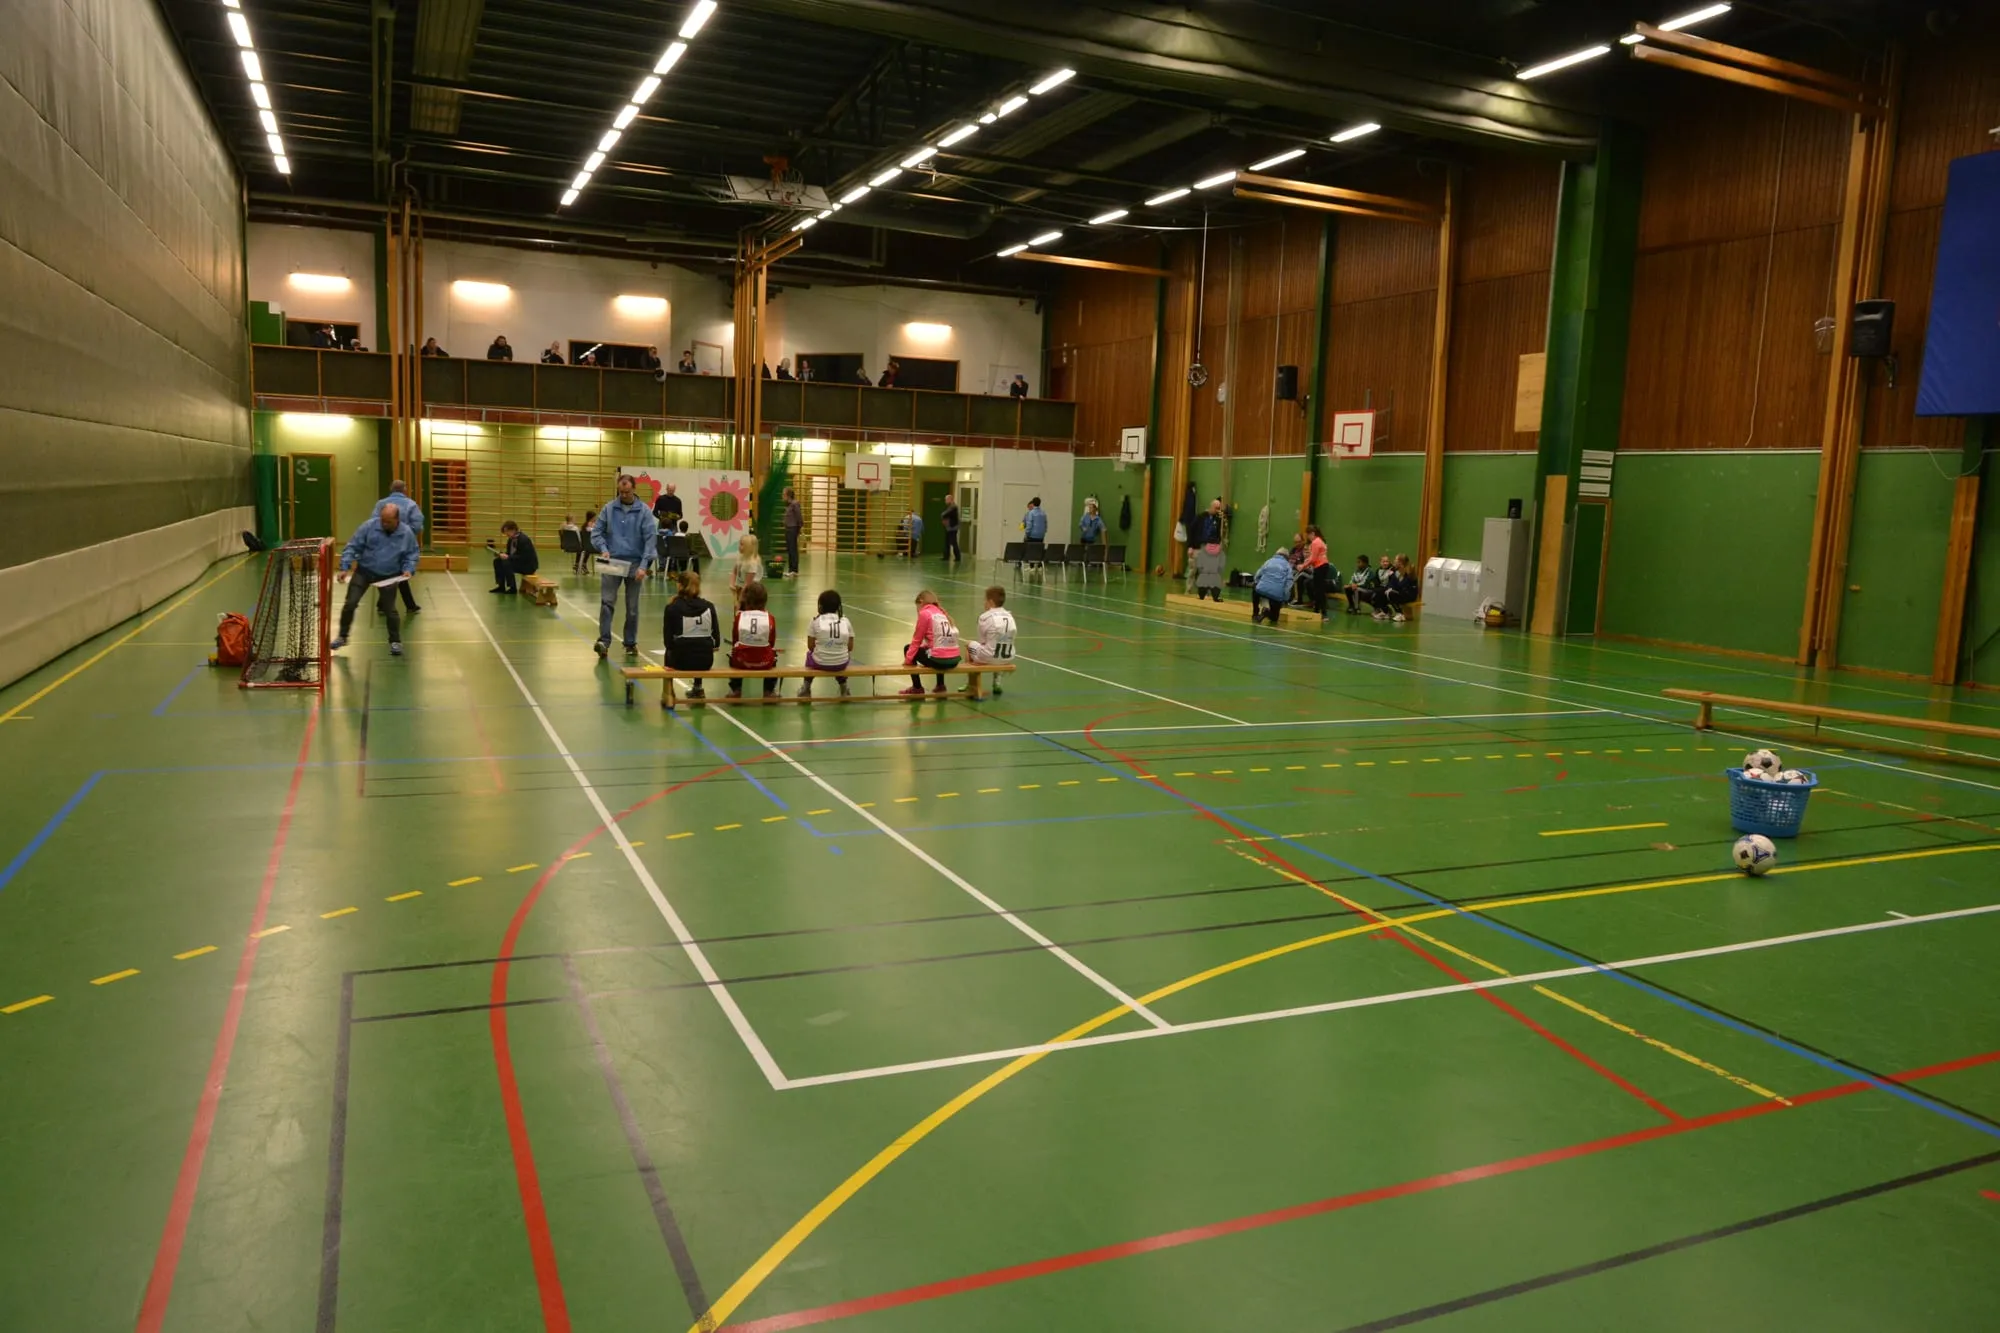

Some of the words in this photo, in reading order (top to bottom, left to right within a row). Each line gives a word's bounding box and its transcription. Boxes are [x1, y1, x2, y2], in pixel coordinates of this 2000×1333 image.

[296, 459, 310, 475] 3
[750, 618, 758, 635] 8
[829, 622, 840, 639] 10
[941, 621, 952, 637] 12
[1003, 617, 1009, 633] 7
